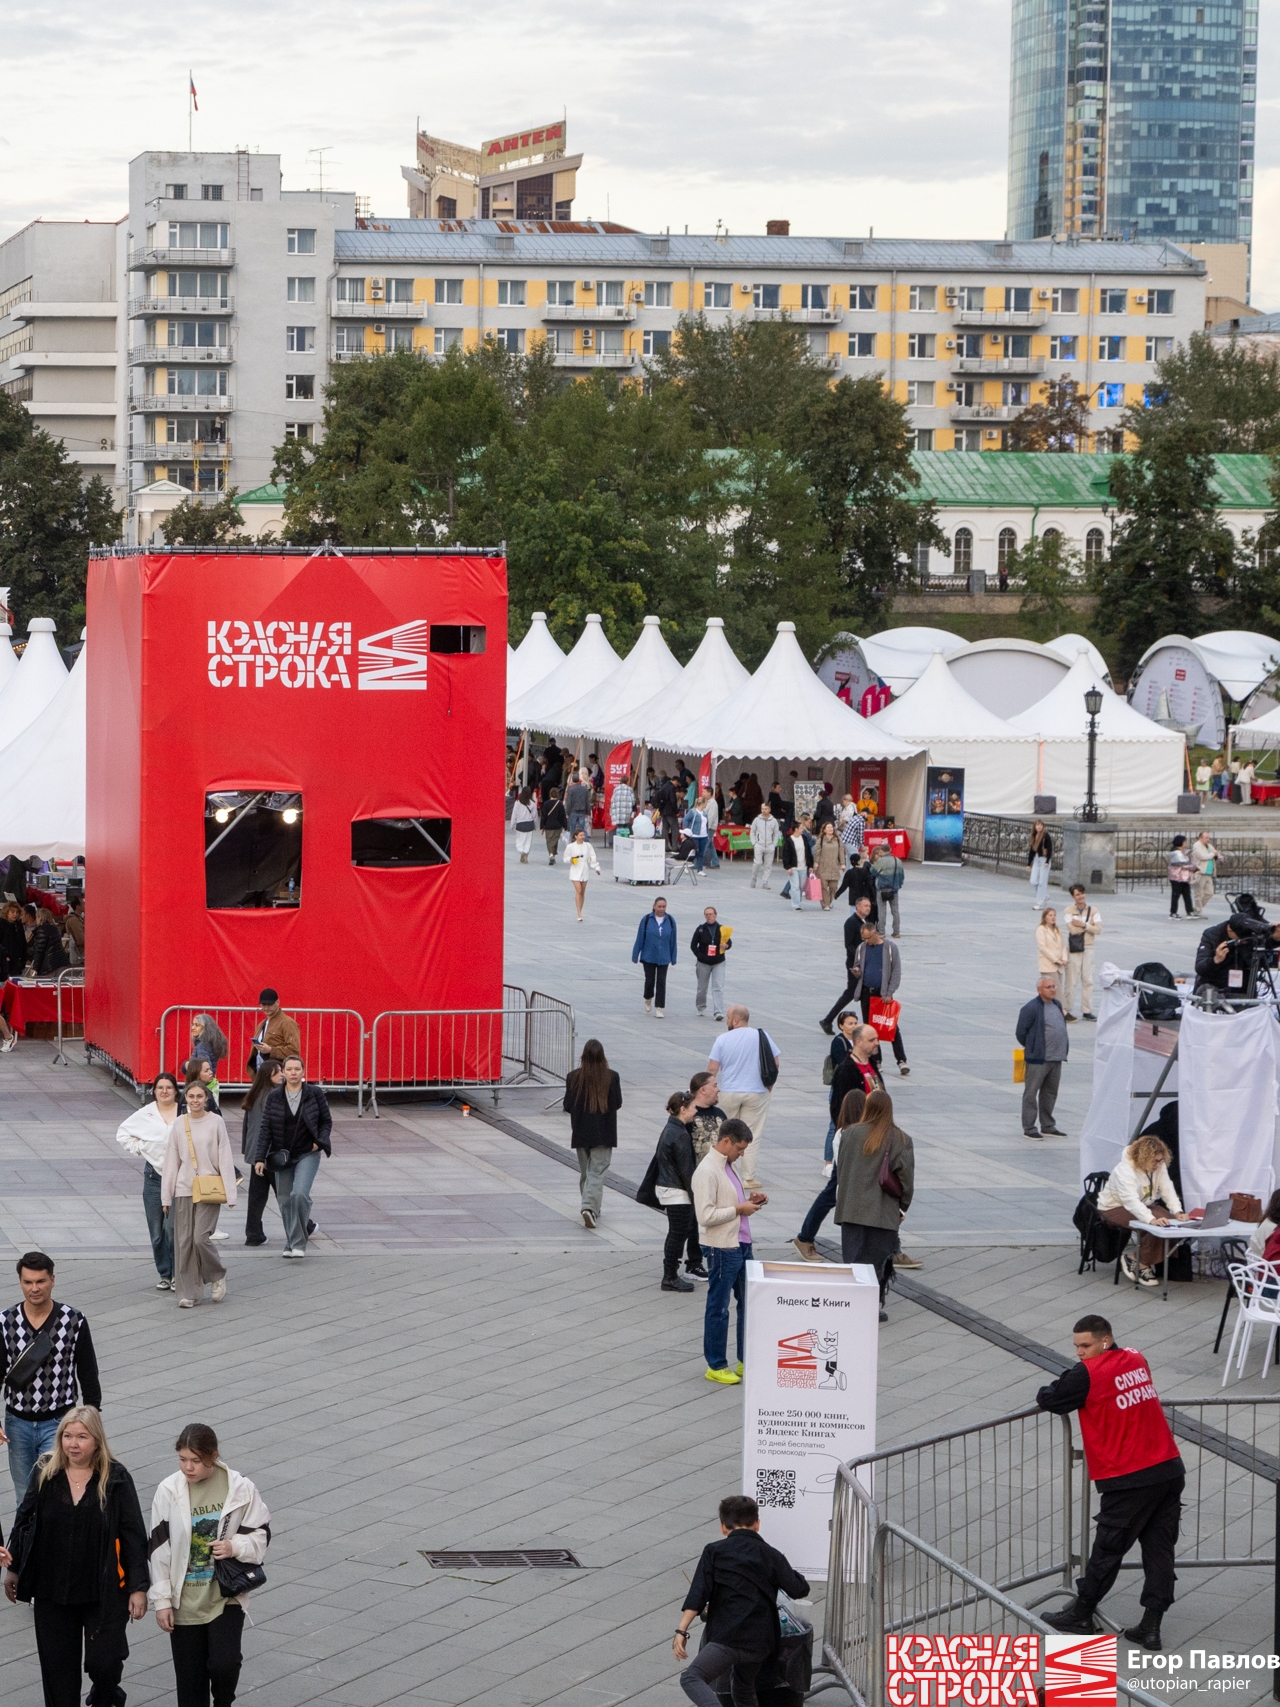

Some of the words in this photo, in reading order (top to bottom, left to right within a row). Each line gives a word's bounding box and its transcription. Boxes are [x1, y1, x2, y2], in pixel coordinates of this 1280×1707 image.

[487, 125, 563, 156] АНТЕЙ
[207, 620, 352, 655] КРАСНАЯ
[207, 654, 352, 689] СТРОКА
[776, 1296, 809, 1307] Яндекс
[823, 1299, 851, 1308] Книги
[777, 1369, 817, 1380] КРАСНАЯ
[777, 1378, 817, 1389] СТРОКА
[758, 1408, 785, 1417] Более
[786, 1409, 803, 1418] 250
[804, 1410, 822, 1419] 000
[823, 1413, 849, 1421] книг,
[757, 1419, 808, 1428] аудиокниг
[819, 1422, 865, 1430] комиксов
[765, 1427, 799, 1437] Яндекс
[801, 1429, 836, 1438] Книгах
[787, 1440, 826, 1449] бесплатно
[768, 1449, 807, 1457] промокоду
[190, 1502, 224, 1517] ABLAN
